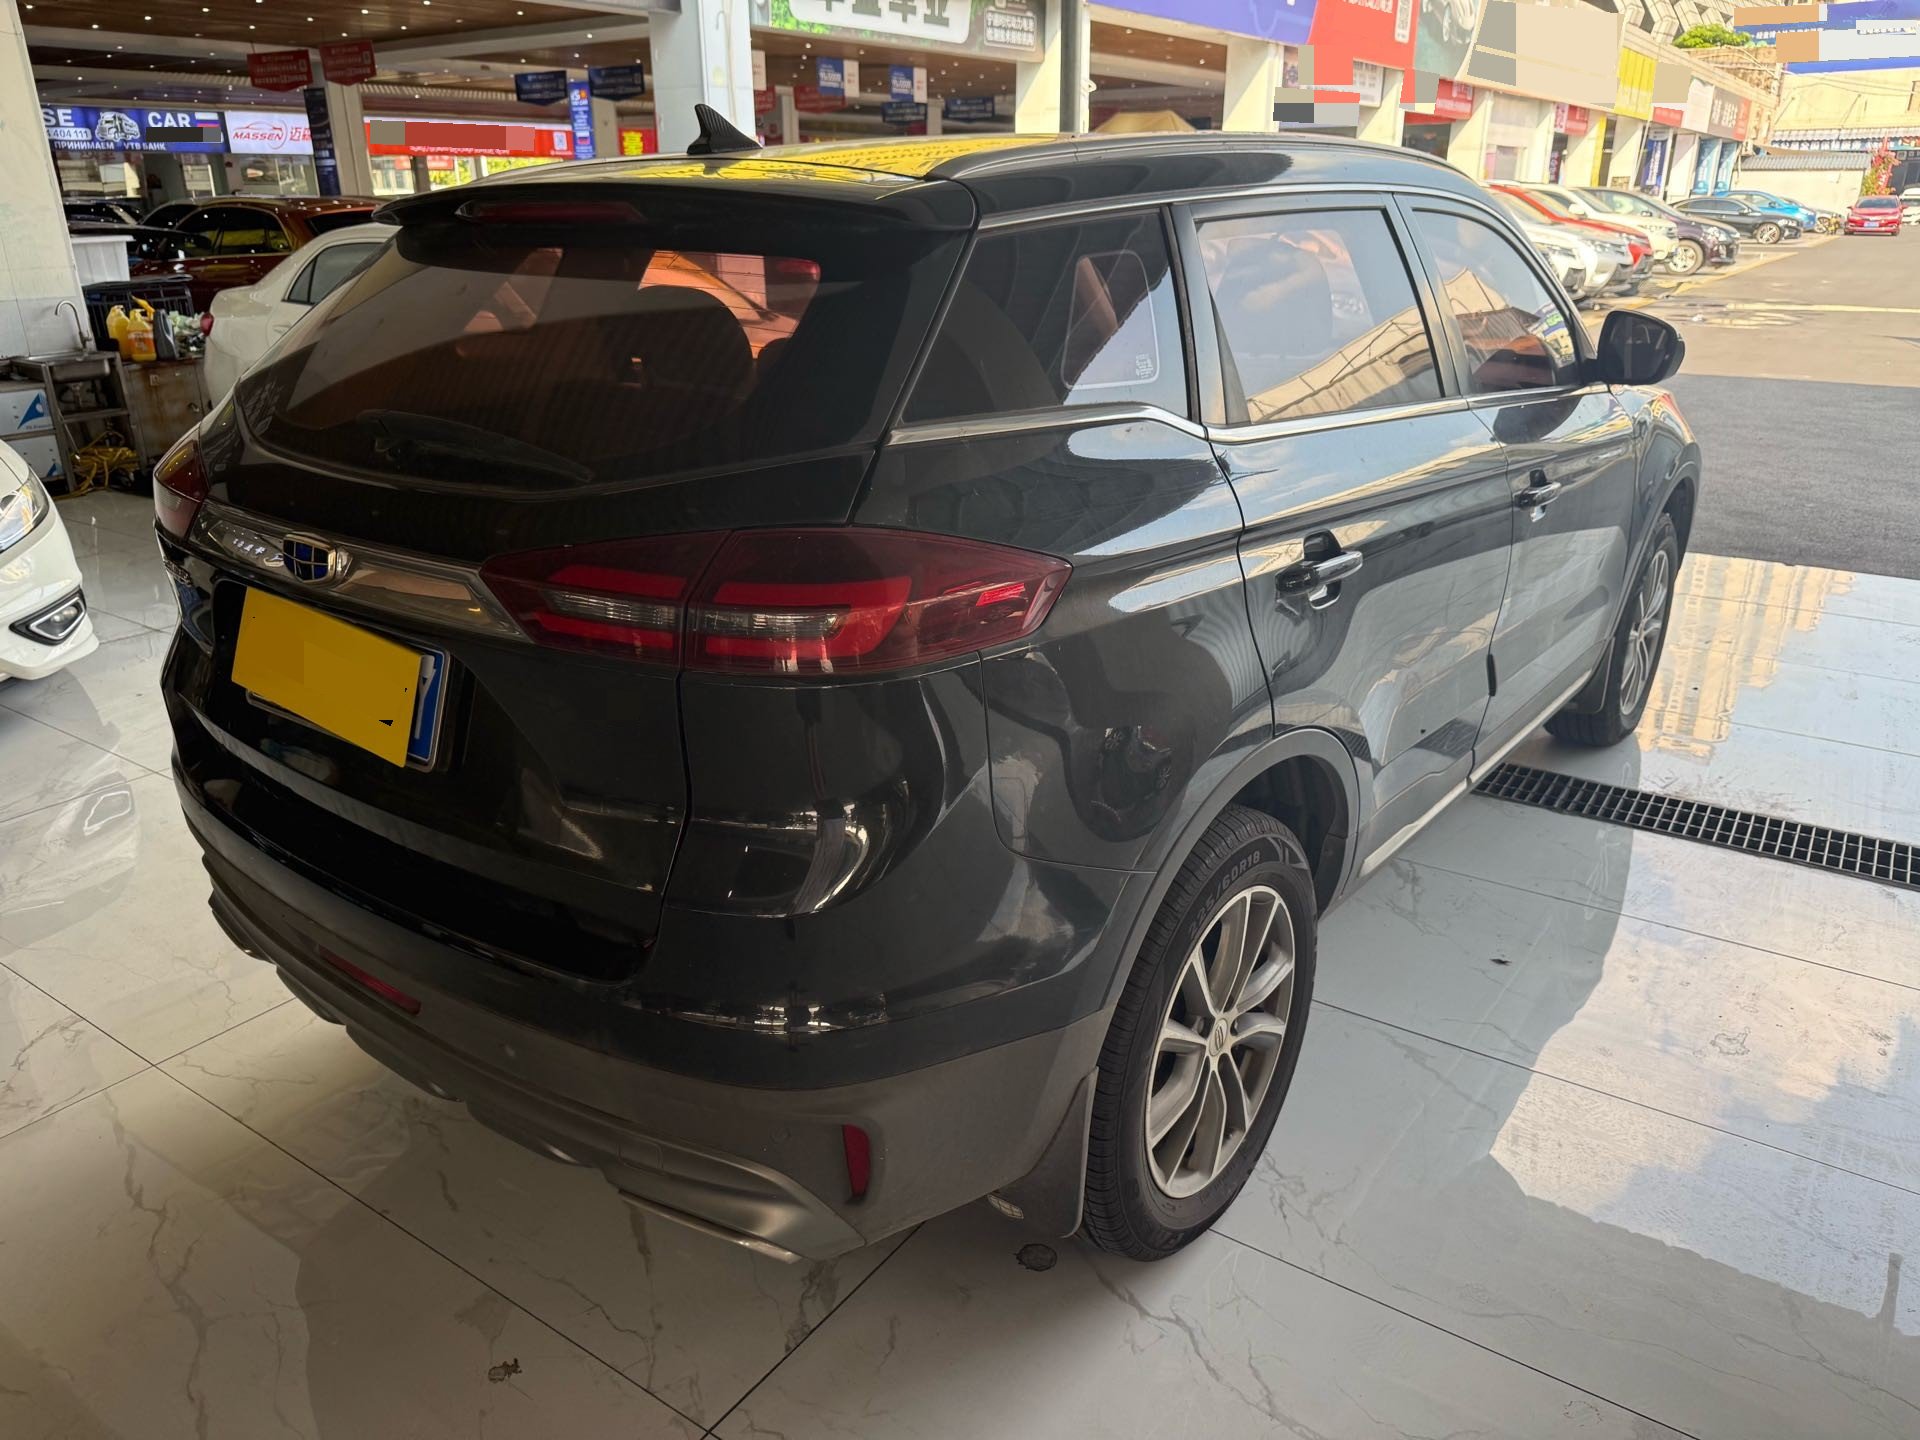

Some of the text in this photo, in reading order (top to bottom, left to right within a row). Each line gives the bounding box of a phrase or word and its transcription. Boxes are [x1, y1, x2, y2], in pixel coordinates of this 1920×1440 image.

[148, 111, 191, 128] CAR
[73, 130, 89, 139] 111
[233, 131, 283, 141] MASSEN
[54, 141, 115, 151] ПРИНИМАЕМ
